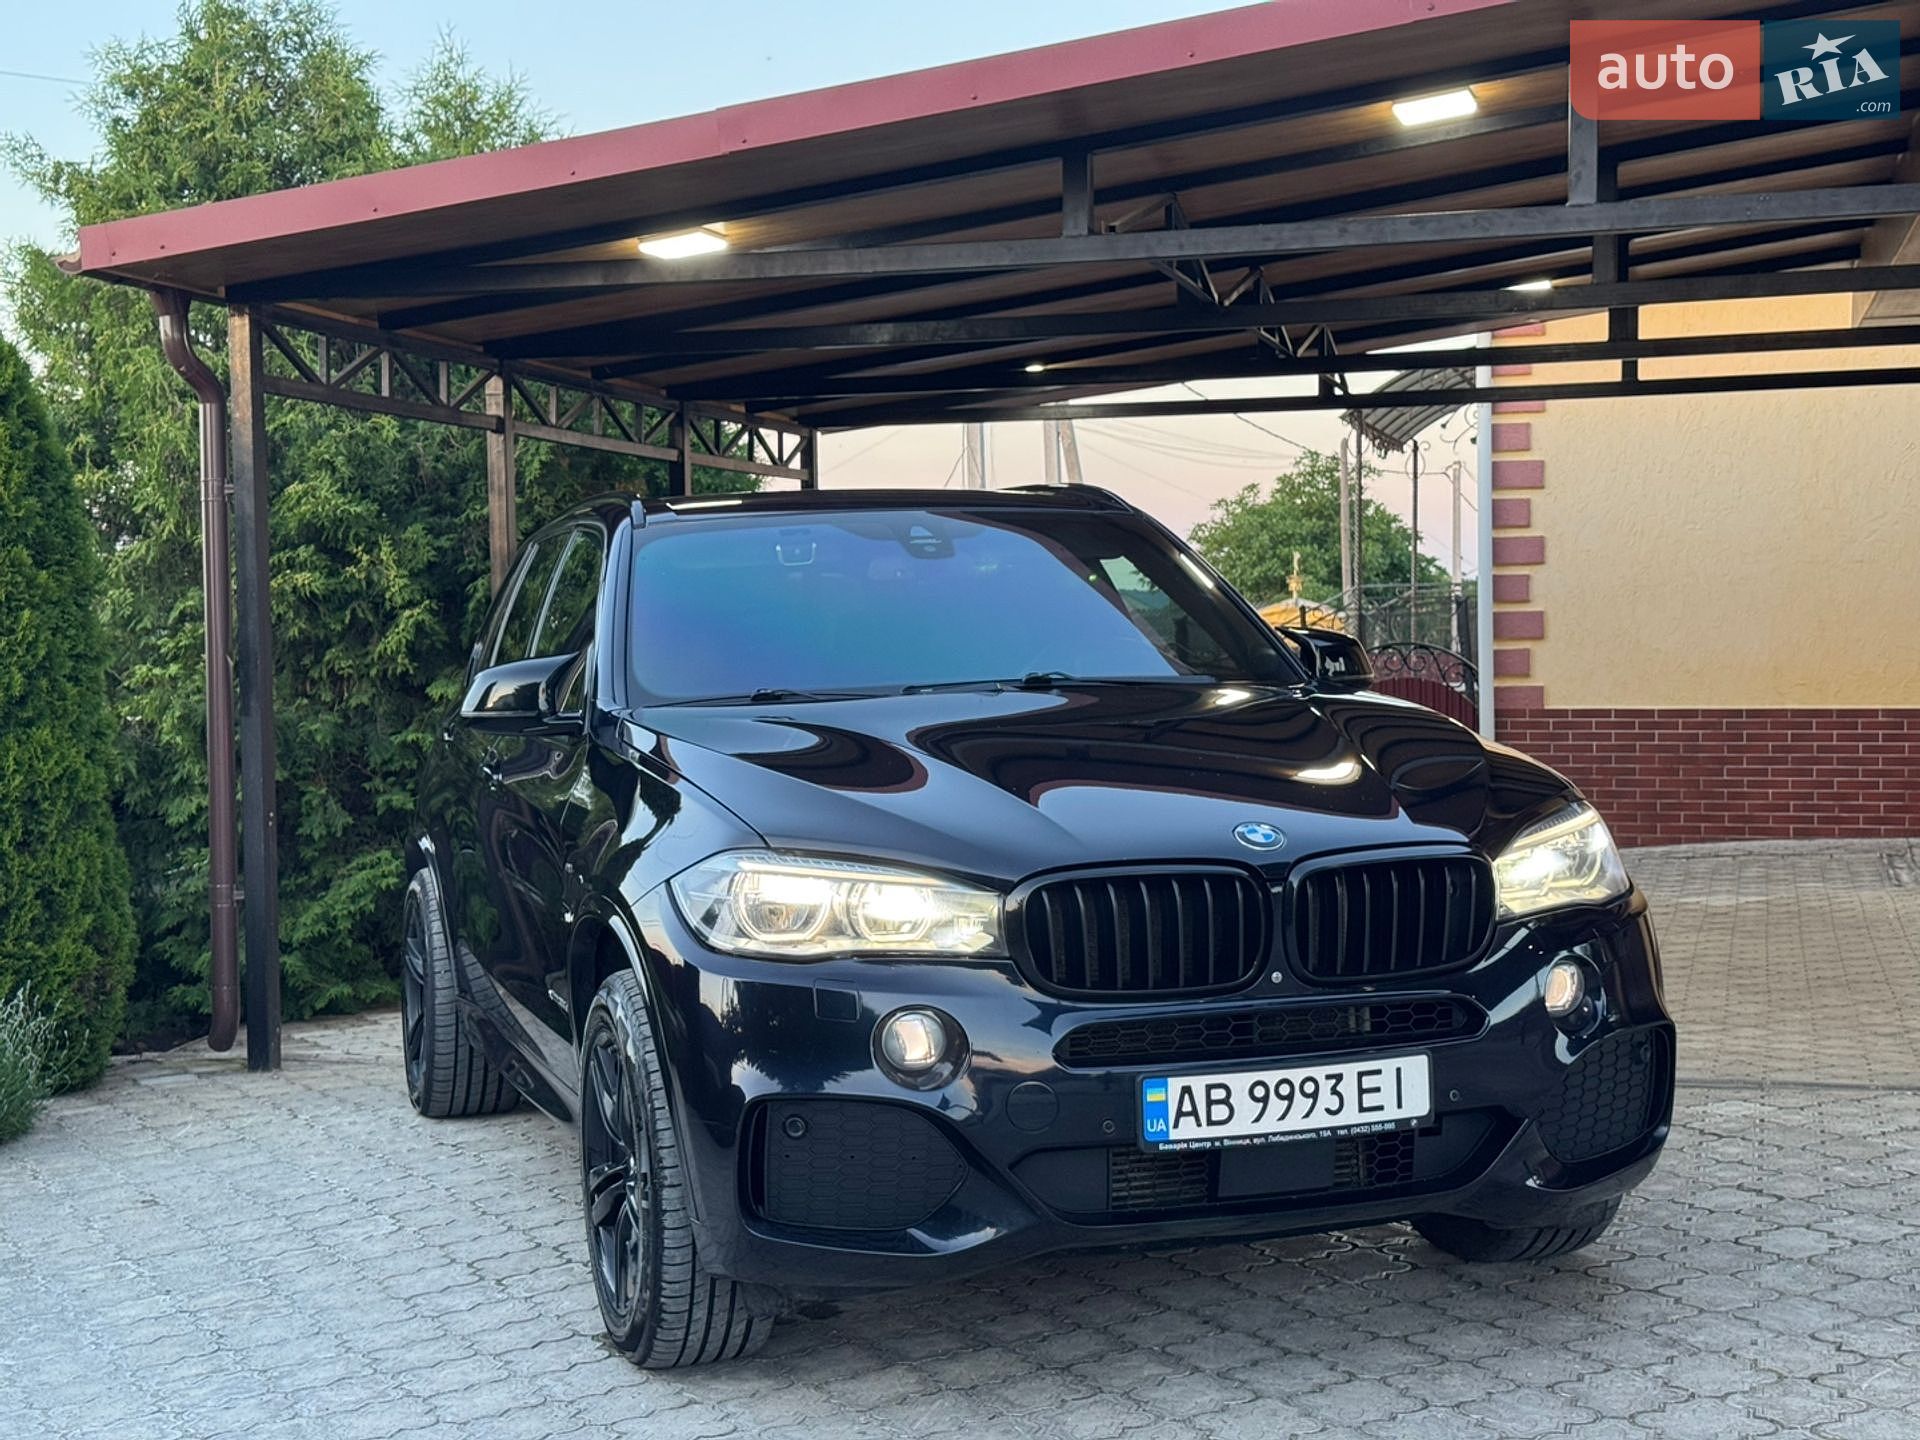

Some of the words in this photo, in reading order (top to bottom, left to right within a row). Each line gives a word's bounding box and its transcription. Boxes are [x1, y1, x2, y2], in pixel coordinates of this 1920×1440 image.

[1172, 1082, 1235, 1130] AB
[1248, 1072, 1345, 1123] 9993
[1147, 1114, 1167, 1132] UA
